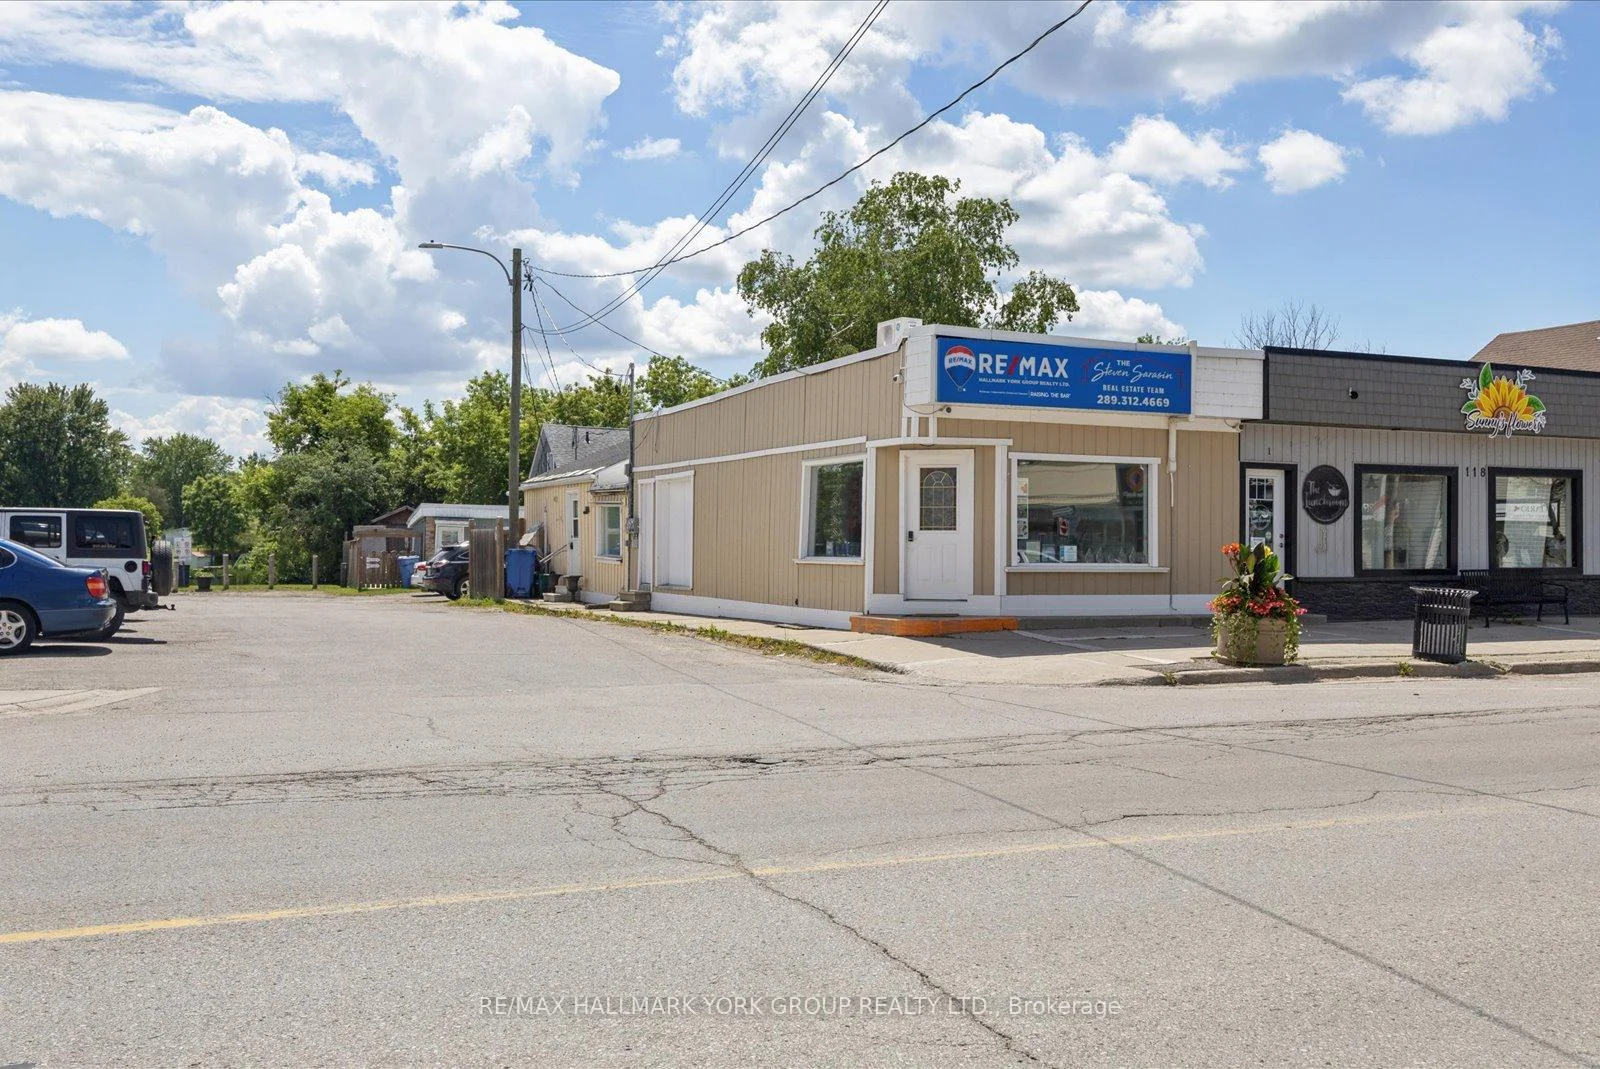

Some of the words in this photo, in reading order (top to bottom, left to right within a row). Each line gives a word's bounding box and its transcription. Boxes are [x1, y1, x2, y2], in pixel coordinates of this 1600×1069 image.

[948, 356, 973, 366] RE/MAX
[979, 353, 1069, 379] RE/MAX
[1091, 362, 1129, 382] Steven
[1102, 384, 1118, 392] REAL
[1121, 385, 1144, 393] ESTATE
[1097, 395, 1170, 407] 289.312.4669
[1465, 466, 1486, 477] 118
